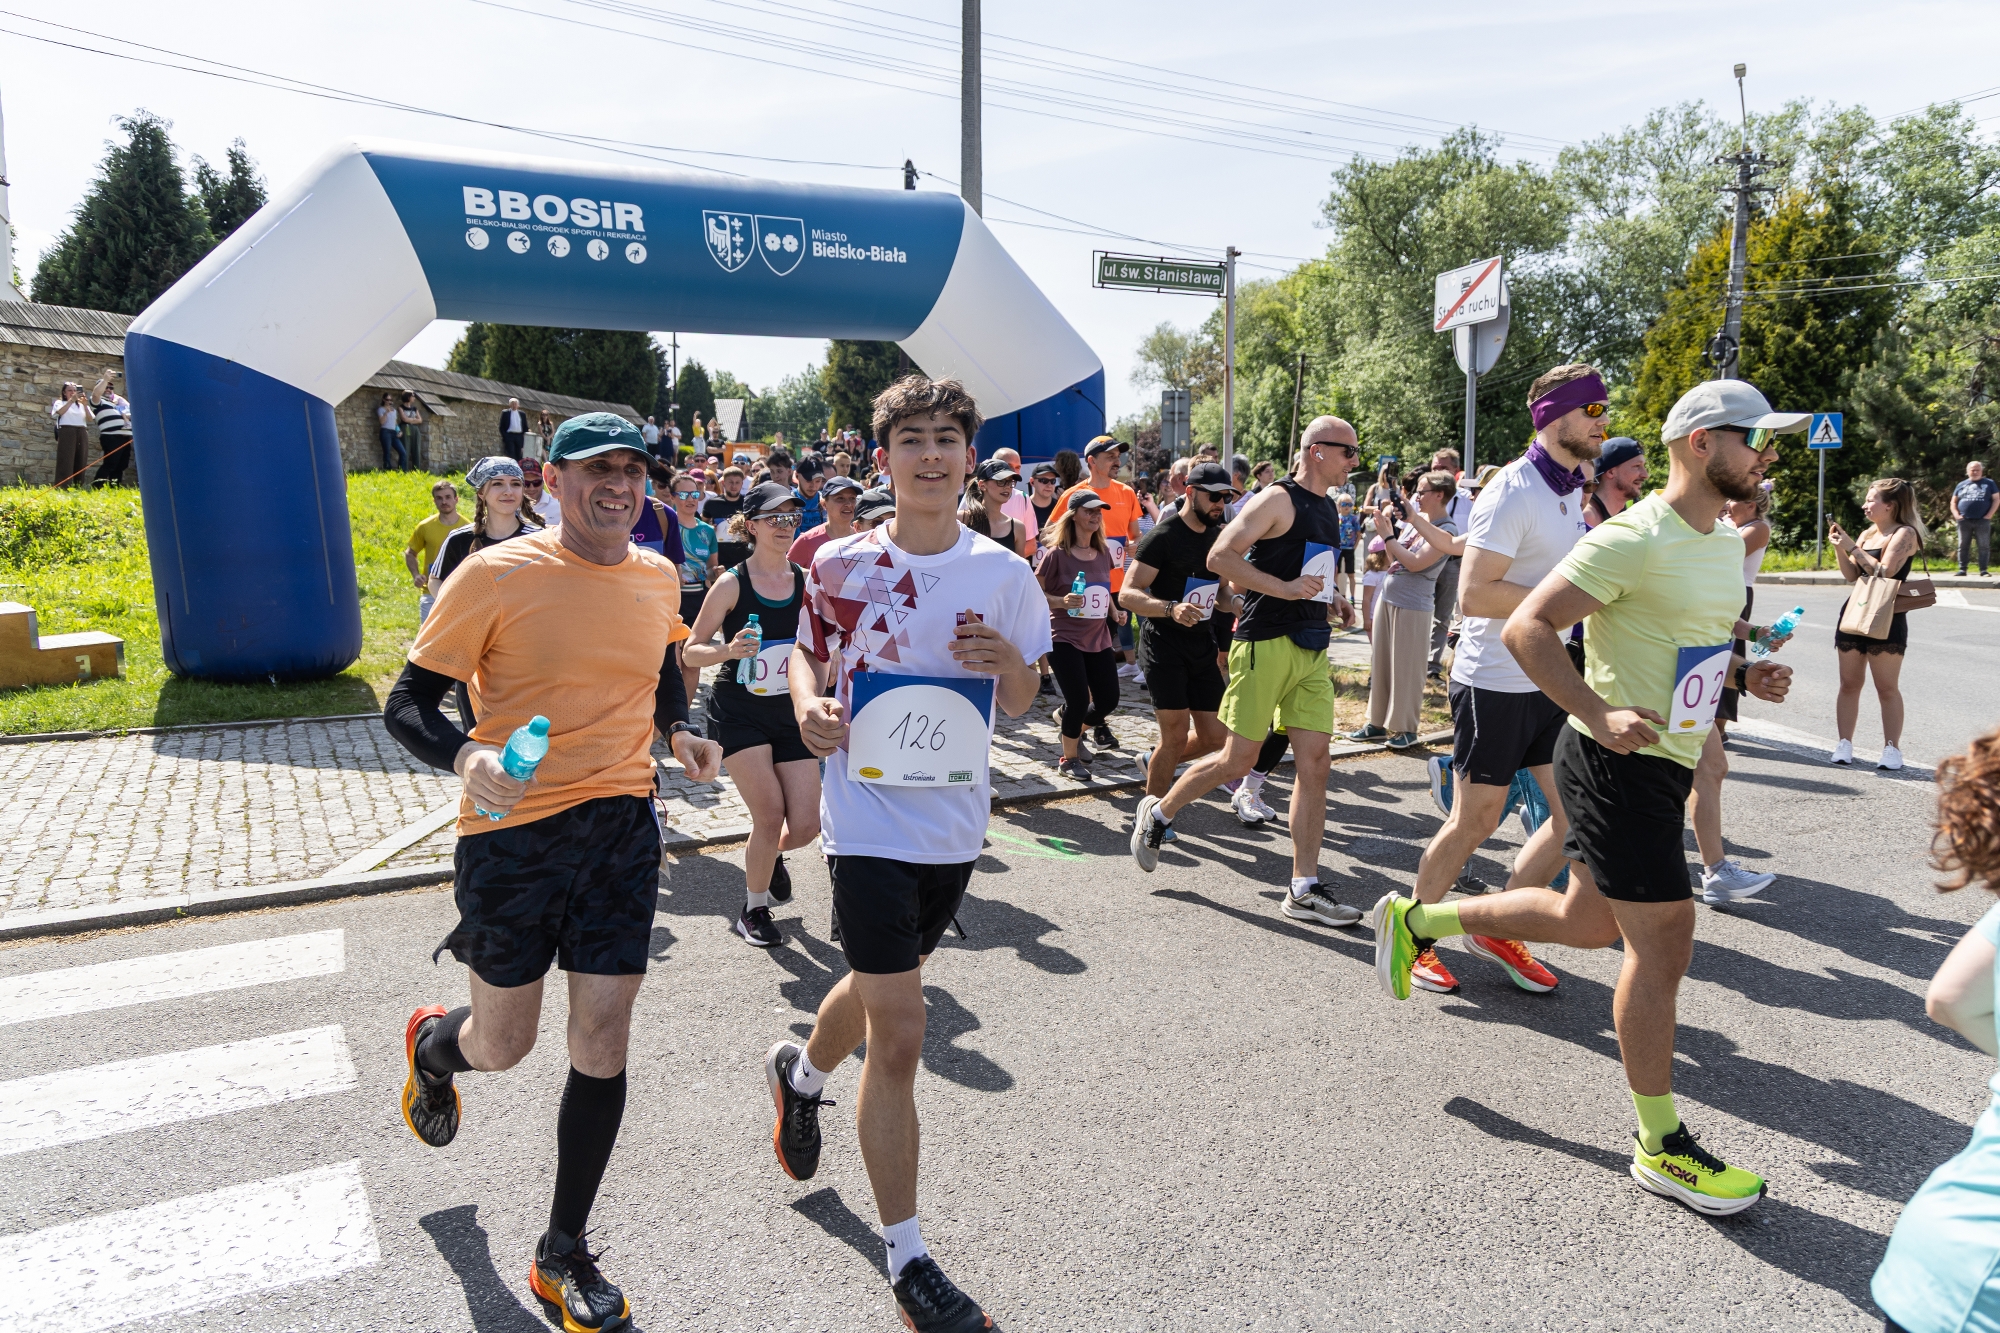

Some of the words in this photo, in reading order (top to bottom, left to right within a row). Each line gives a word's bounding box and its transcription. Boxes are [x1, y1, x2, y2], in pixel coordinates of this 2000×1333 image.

[463, 186, 645, 232] BBOSiR
[466, 218, 531, 230] BIELSKO-BIALSKI
[532, 224, 570, 234] OŚRODEK
[571, 228, 601, 237] SPORTU
[606, 231, 647, 241] REKREACJI
[811, 229, 847, 242] Miasto
[812, 241, 907, 263] Bielsko-Biała
[1104, 264, 1118, 278] ul.
[1120, 264, 1141, 279] św.
[1144, 266, 1221, 285] Stanisława
[1468, 295, 1497, 313] ruchu
[75, 655, 92, 678] 3
[888, 711, 946, 751] 126
[903, 773, 936, 781] Ustronianka
[1660, 1159, 1698, 1187] HOKA
